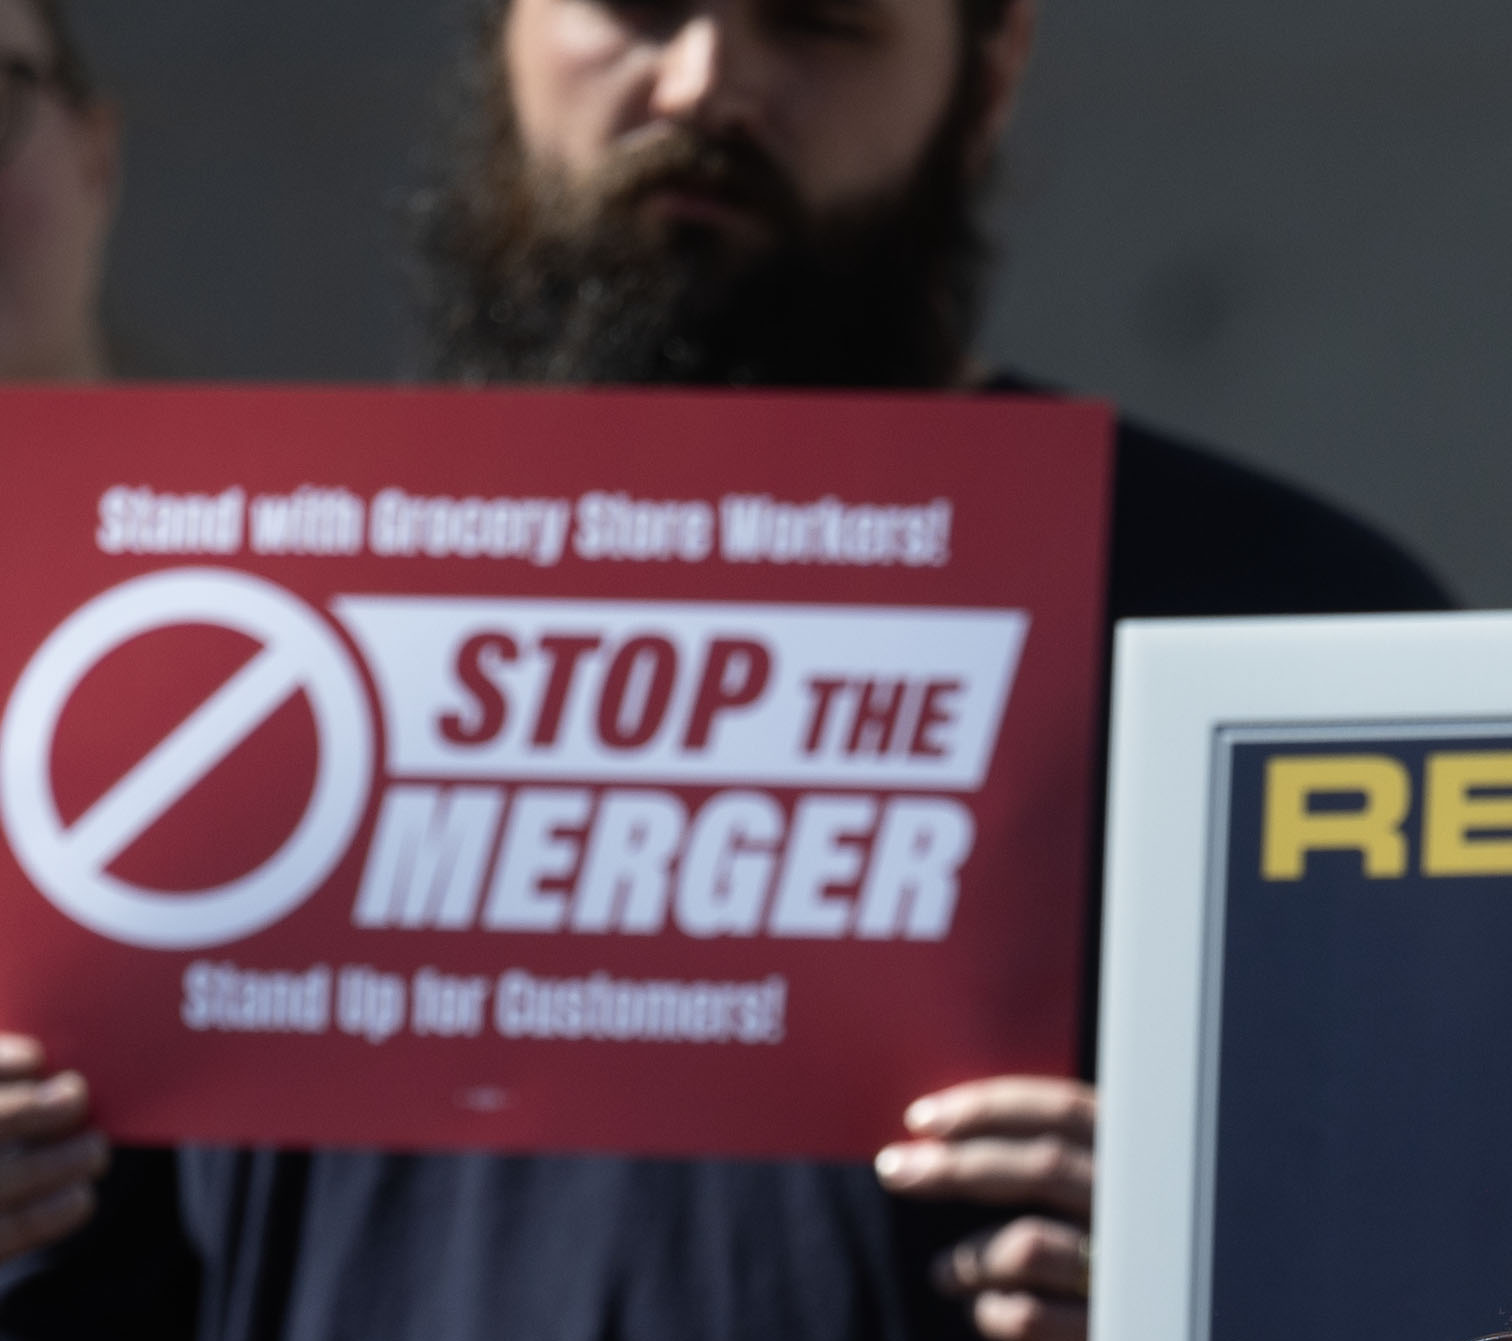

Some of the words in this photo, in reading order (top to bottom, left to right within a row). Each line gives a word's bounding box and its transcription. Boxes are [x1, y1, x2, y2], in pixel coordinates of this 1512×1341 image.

[96, 484, 245, 556] Stand
[250, 484, 364, 556] with
[370, 487, 568, 566] Grocery
[573, 490, 714, 562] Store
[718, 492, 953, 566] Workers!
[436, 629, 775, 753] STOP
[795, 675, 965, 764] THE
[352, 787, 977, 941] MERGER
[181, 962, 333, 1034] Stand
[337, 964, 406, 1045] Up
[410, 966, 487, 1036] for
[494, 968, 786, 1044] Customers!
